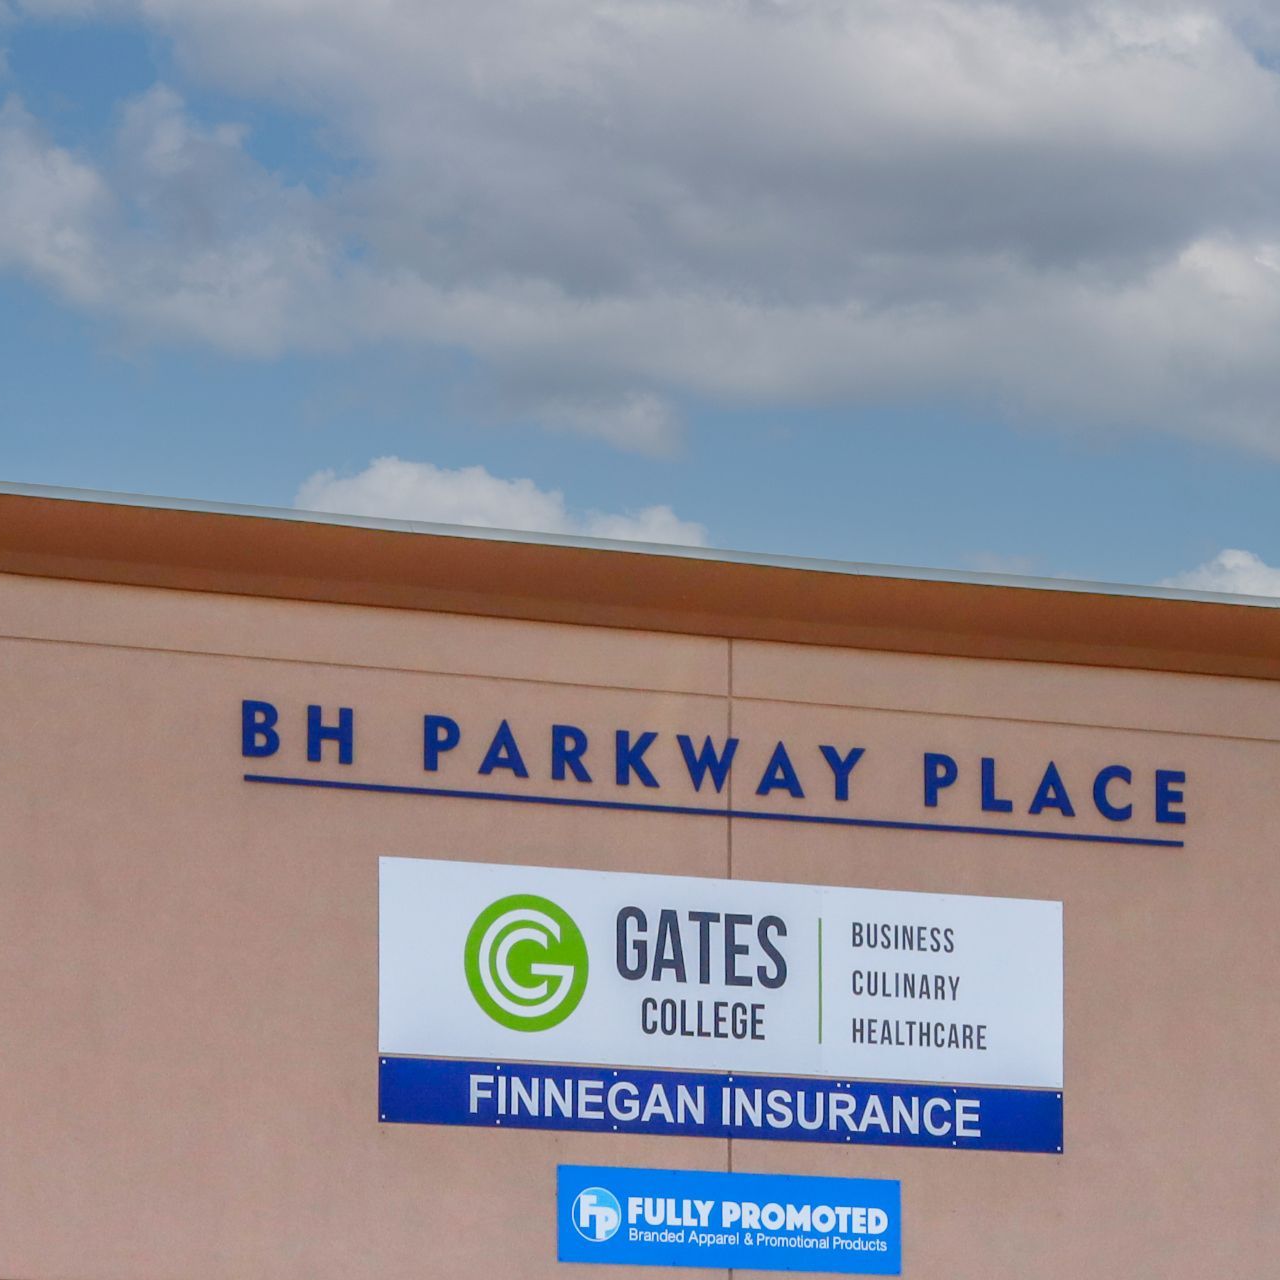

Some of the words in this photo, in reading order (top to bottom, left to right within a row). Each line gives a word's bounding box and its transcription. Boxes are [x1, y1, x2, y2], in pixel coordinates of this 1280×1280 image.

[241, 700, 354, 765] BH
[423, 715, 867, 803] PARKWAY
[924, 752, 1188, 825] PLACE
[616, 906, 787, 989] GATES
[852, 922, 955, 954] BUSINESS
[852, 970, 961, 1002] CULINARY
[641, 998, 765, 1041] COLLEGE
[852, 1018, 988, 1050] HEALTHCARE
[469, 1074, 705, 1126] FINNEGAN
[722, 1087, 982, 1138] INSURANCE
[628, 1196, 716, 1228] FULLY
[722, 1201, 889, 1235] PROMOTED
[629, 1228, 685, 1244] Branded
[688, 1230, 740, 1247] Apparel
[744, 1233, 754, 1246] &
[756, 1233, 830, 1250] Promotional
[833, 1236, 888, 1252] Products
